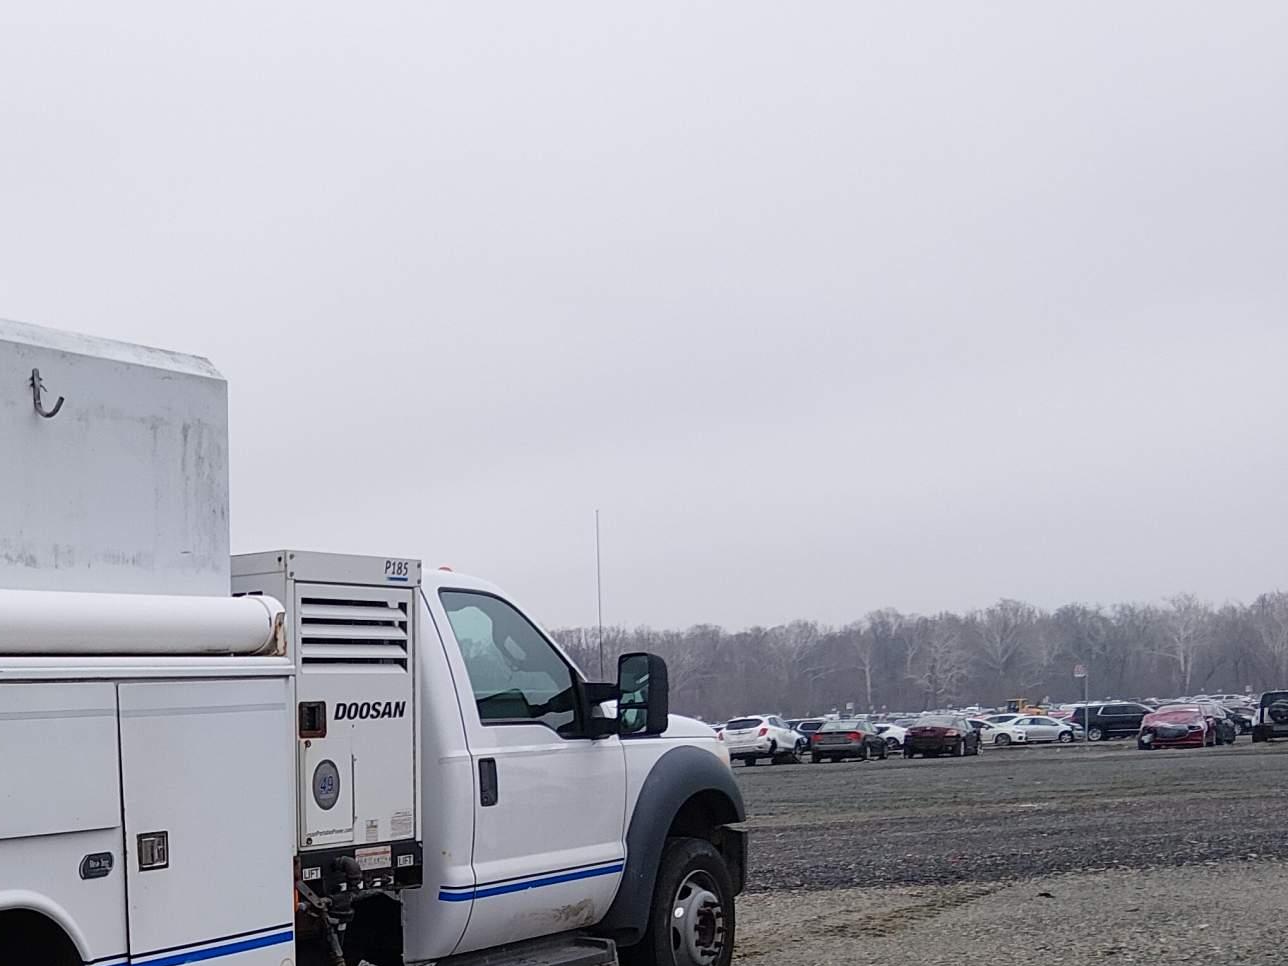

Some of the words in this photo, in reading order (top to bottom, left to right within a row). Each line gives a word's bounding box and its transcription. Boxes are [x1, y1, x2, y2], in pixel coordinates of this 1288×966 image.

[384, 560, 408, 576] P185
[333, 701, 406, 721] DOOSAN
[397, 856, 412, 866] LIFT
[304, 869, 319, 879] LIFT
